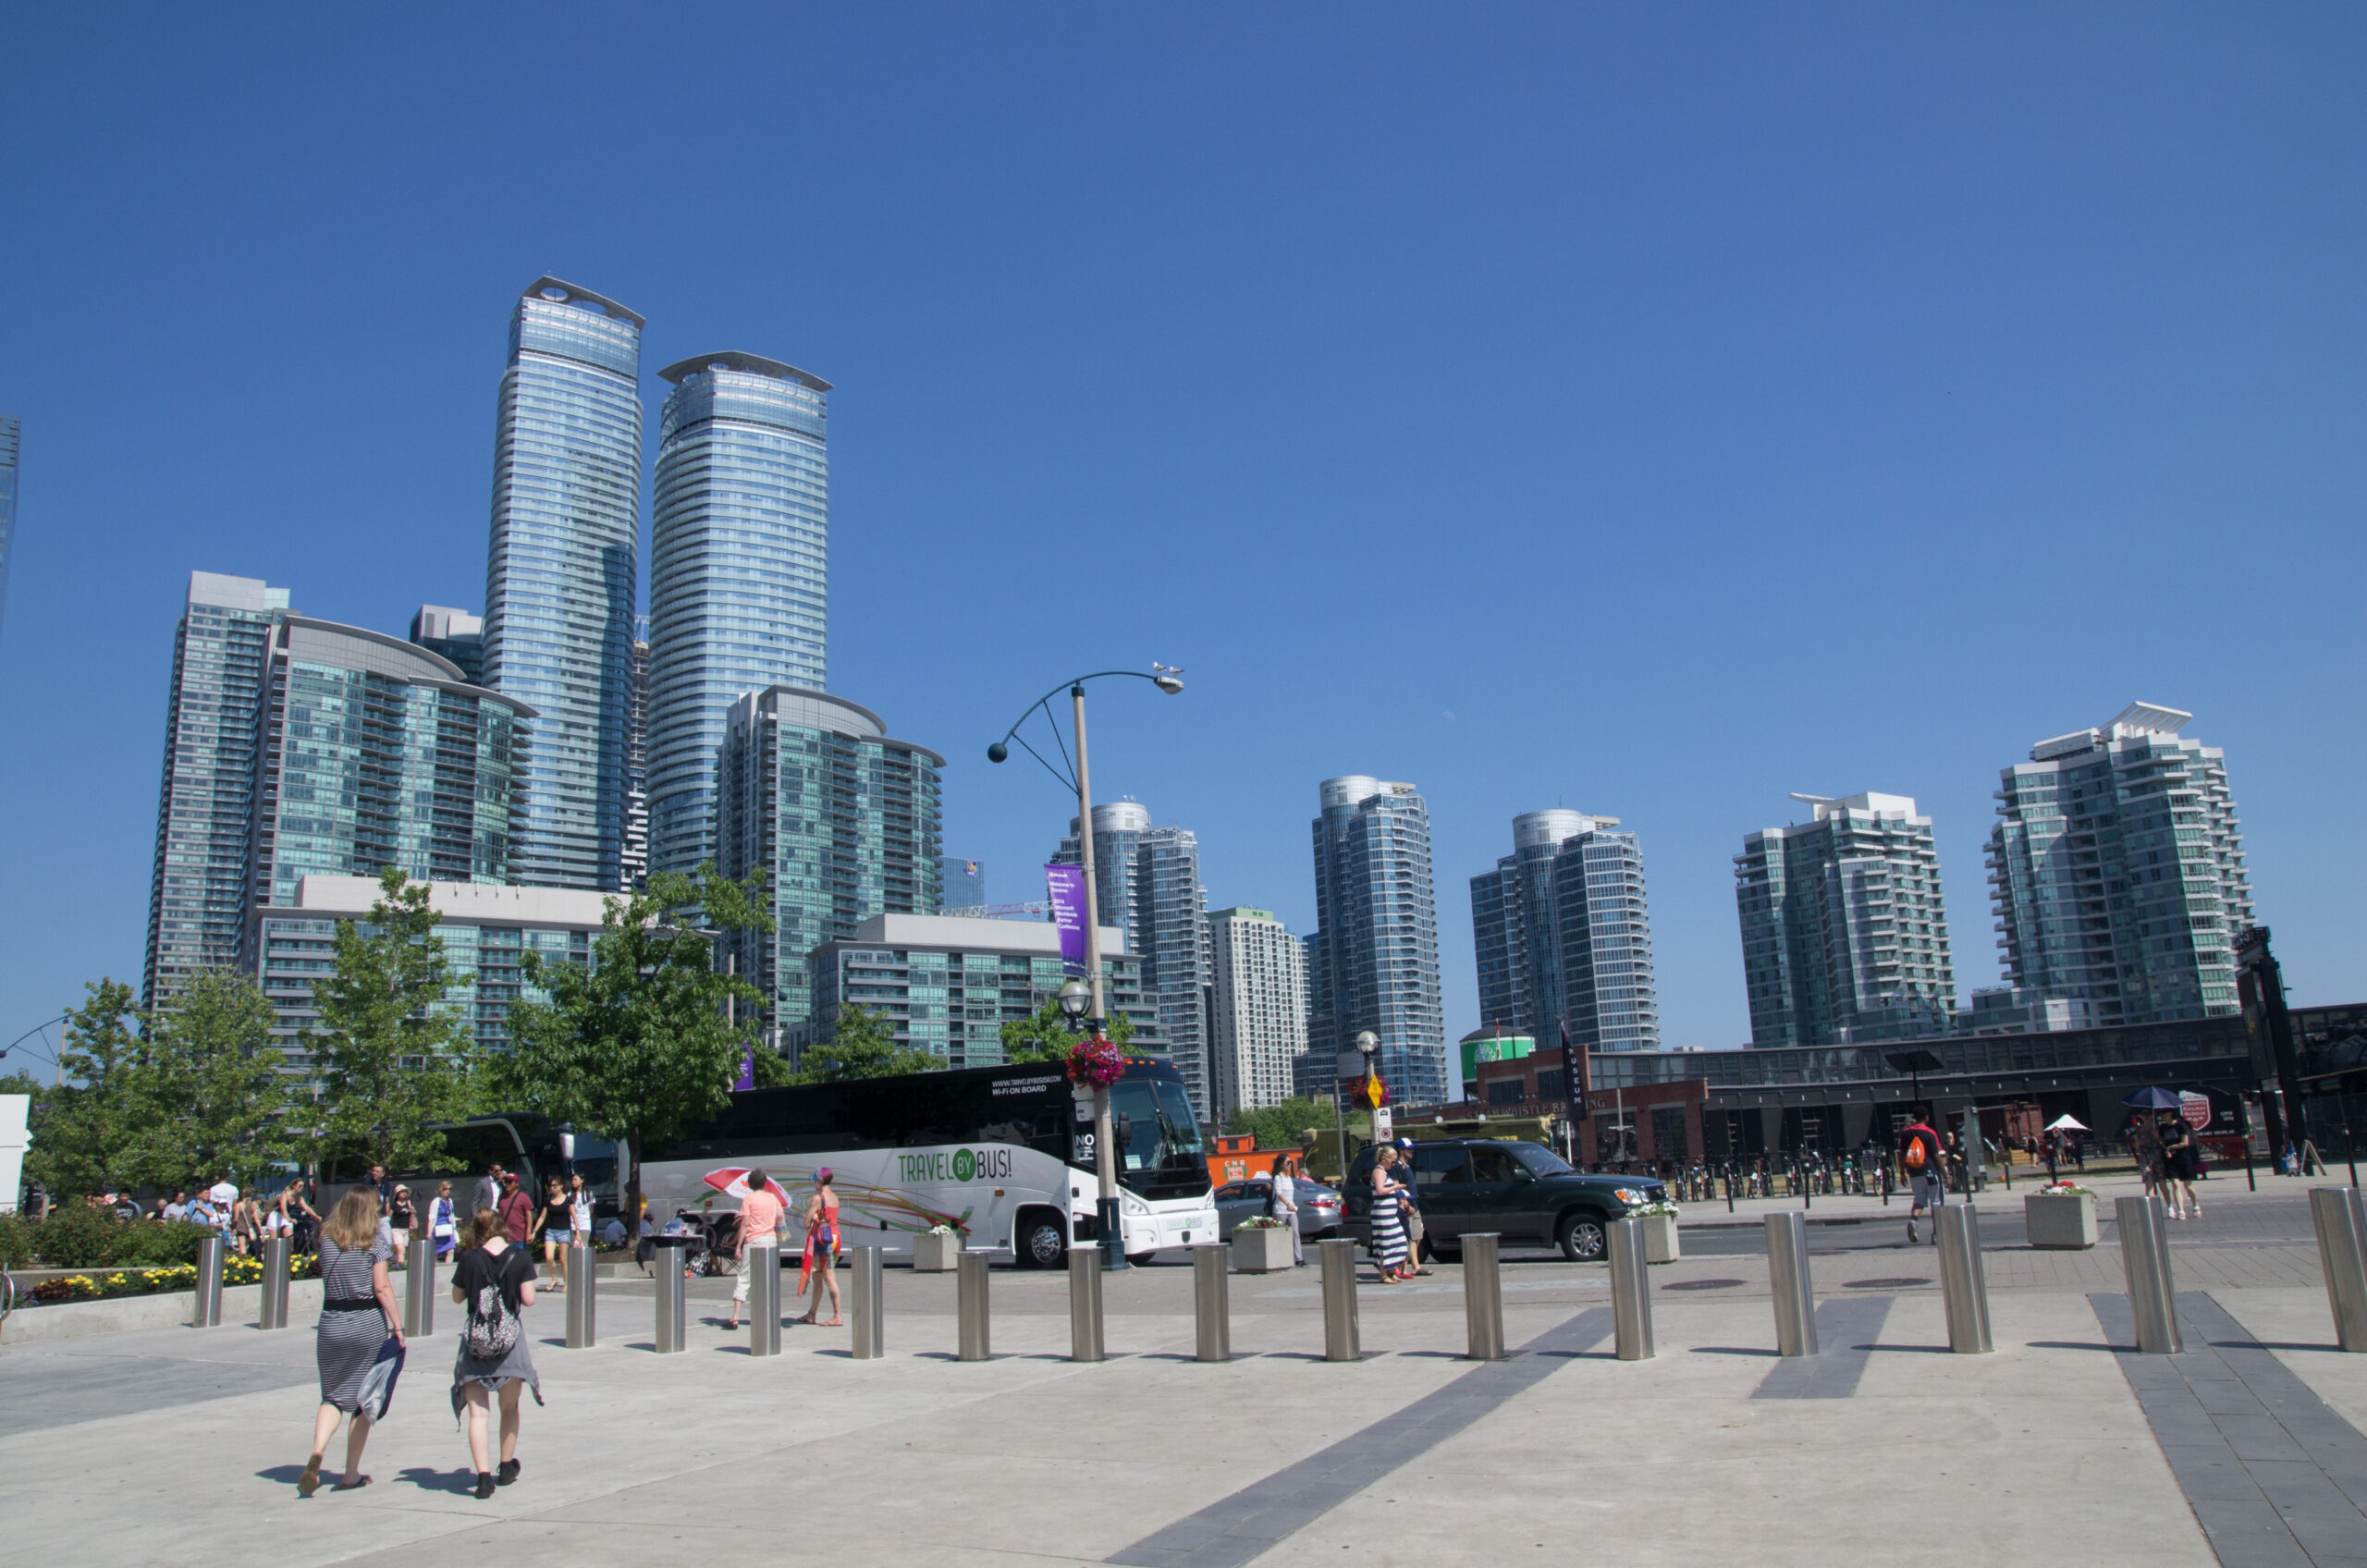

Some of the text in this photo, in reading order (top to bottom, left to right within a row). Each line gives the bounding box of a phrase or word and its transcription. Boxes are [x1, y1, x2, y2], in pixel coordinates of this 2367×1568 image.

[1568, 1047, 1582, 1104] MUSEUM
[1022, 1084, 1047, 1094] BOARD
[1502, 1104, 1549, 1116] WHISTLE
[1552, 1097, 1606, 1113] BRING
[1075, 1133, 1095, 1145] NO
[898, 1148, 1012, 1182] TRAVEL BY BUS!
